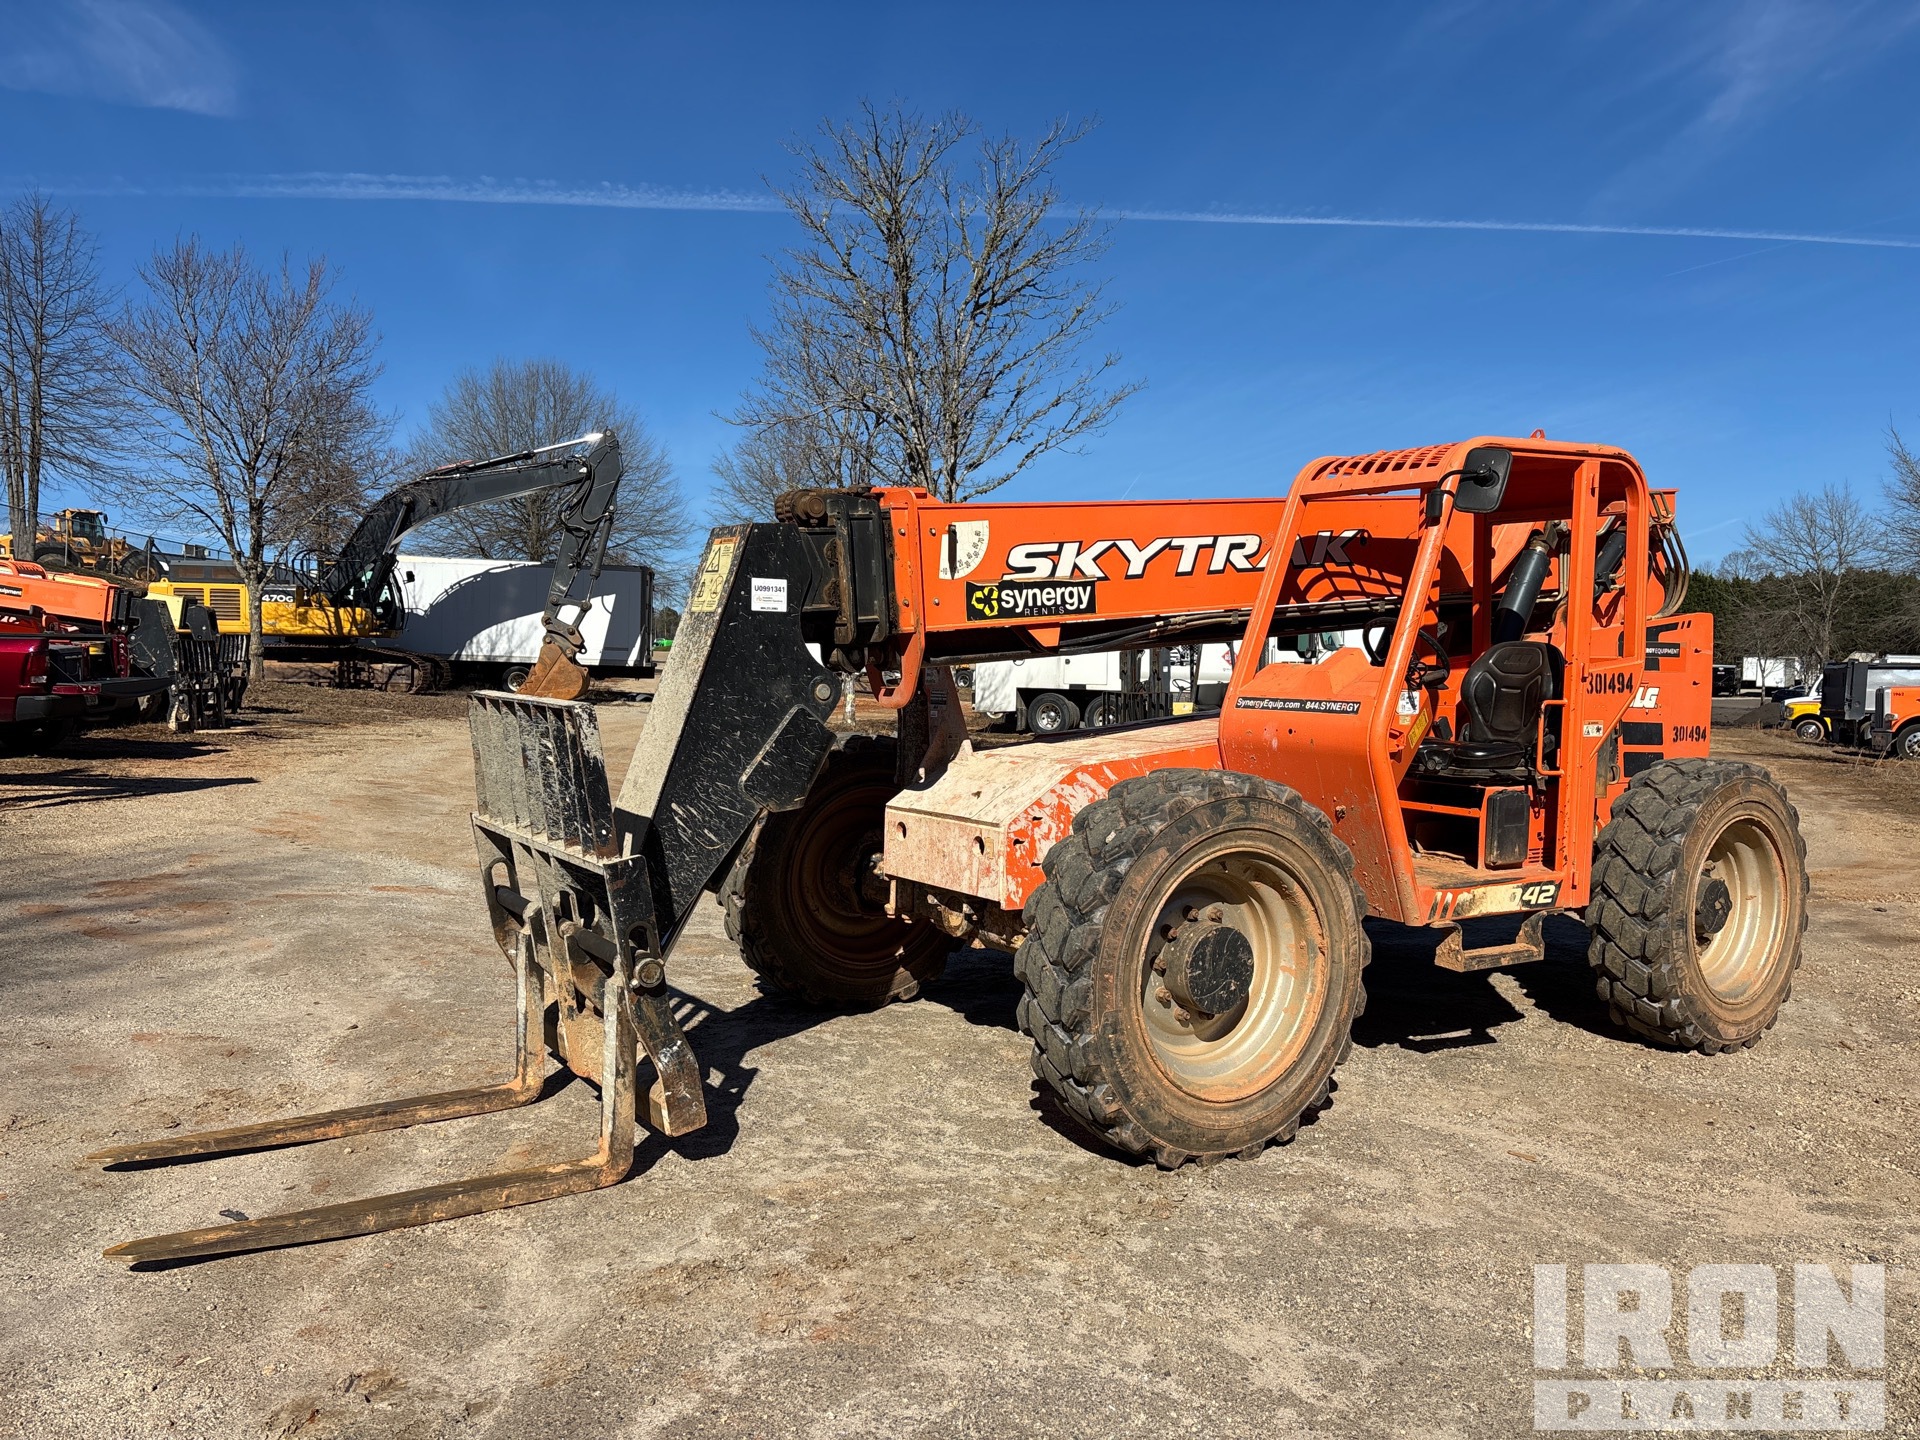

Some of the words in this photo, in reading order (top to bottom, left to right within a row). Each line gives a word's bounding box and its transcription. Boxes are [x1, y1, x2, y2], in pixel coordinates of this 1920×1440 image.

[754, 585, 785, 593] U0991341
[261, 594, 294, 603] 470G
[1001, 585, 1091, 613] synergy
[1025, 606, 1065, 616] RENTS
[1586, 672, 1633, 694] 301494
[1236, 698, 1301, 709] SynergyEquip.com
[1305, 701, 1360, 712] 844.SYNERGY
[1629, 686, 1661, 709] LG
[1672, 725, 1707, 743] 301494
